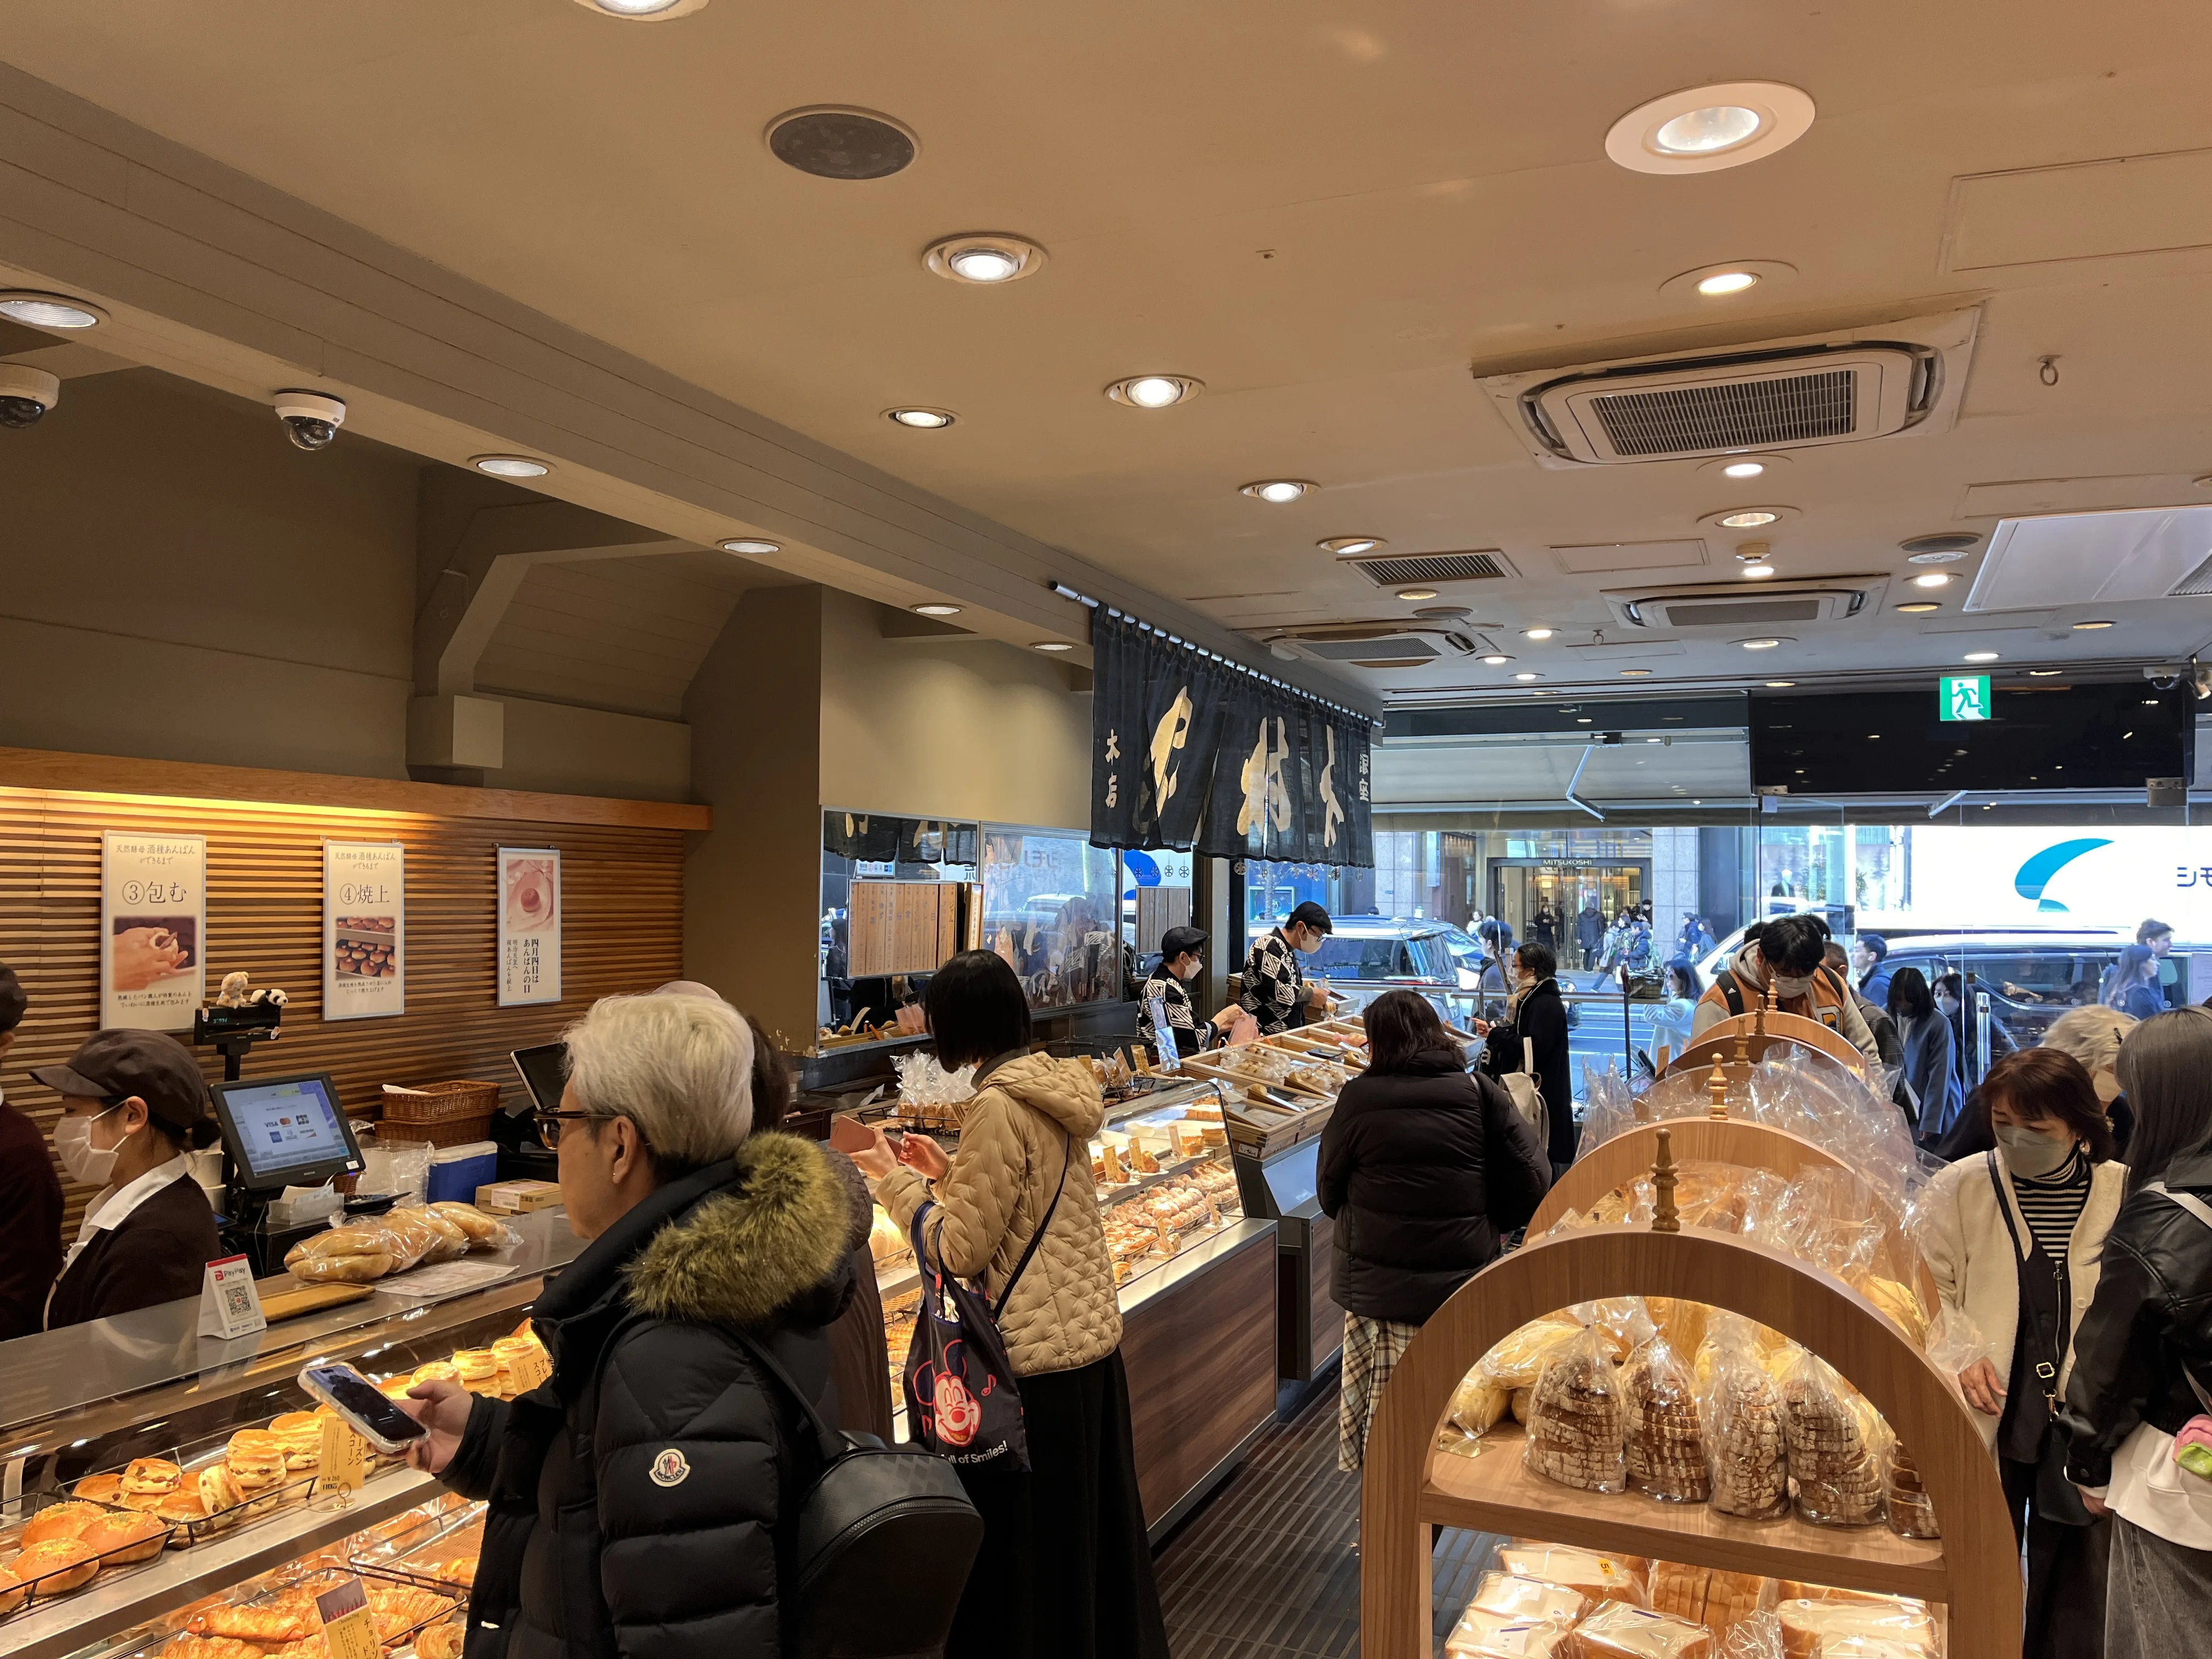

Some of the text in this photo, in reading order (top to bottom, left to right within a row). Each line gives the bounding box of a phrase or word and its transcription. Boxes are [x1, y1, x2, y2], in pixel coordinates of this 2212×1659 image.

[2176, 867, 2212, 888] シモ
[223, 1267, 246, 1277] PayPay
[958, 1454, 969, 1464] of
[970, 1440, 1008, 1463] Smiles!
[657, 1469, 683, 1481] MONCLER
